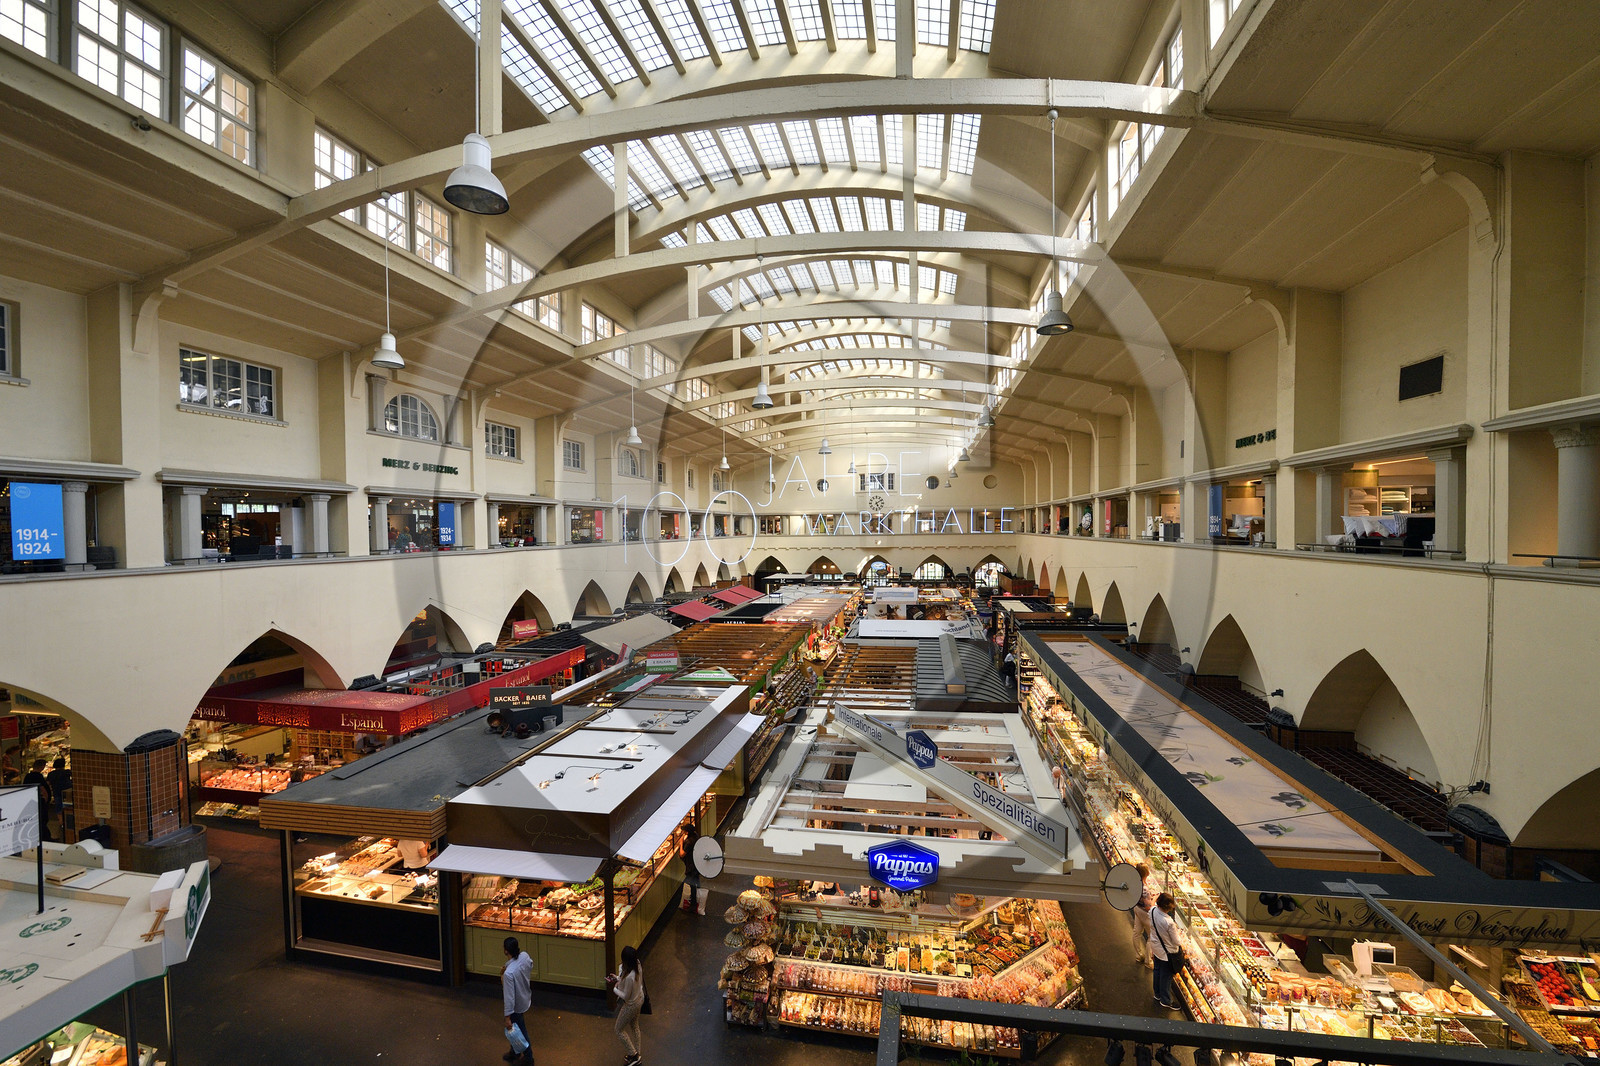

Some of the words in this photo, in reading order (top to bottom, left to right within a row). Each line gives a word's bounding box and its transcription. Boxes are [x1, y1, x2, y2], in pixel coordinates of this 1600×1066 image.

[382, 457, 410, 469] MERZ
[412, 462, 420, 470] &
[422, 463, 458, 475] BENZING
[757, 451, 922, 507] JAHRE
[613, 490, 757, 566] 100
[795, 507, 1015, 536] MARKTHALLE
[16, 529, 58, 540] 1914-
[17, 543, 51, 554] 1924
[494, 695, 520, 703] BÄCKER
[526, 694, 547, 702] BAIER
[191, 705, 226, 718] spanol
[907, 735, 934, 760] Pappas
[839, 708, 882, 741] Internationale
[973, 782, 1056, 843] Spezialitäten
[874, 853, 934, 877] Pappas
[1348, 902, 1447, 934] Feikost
